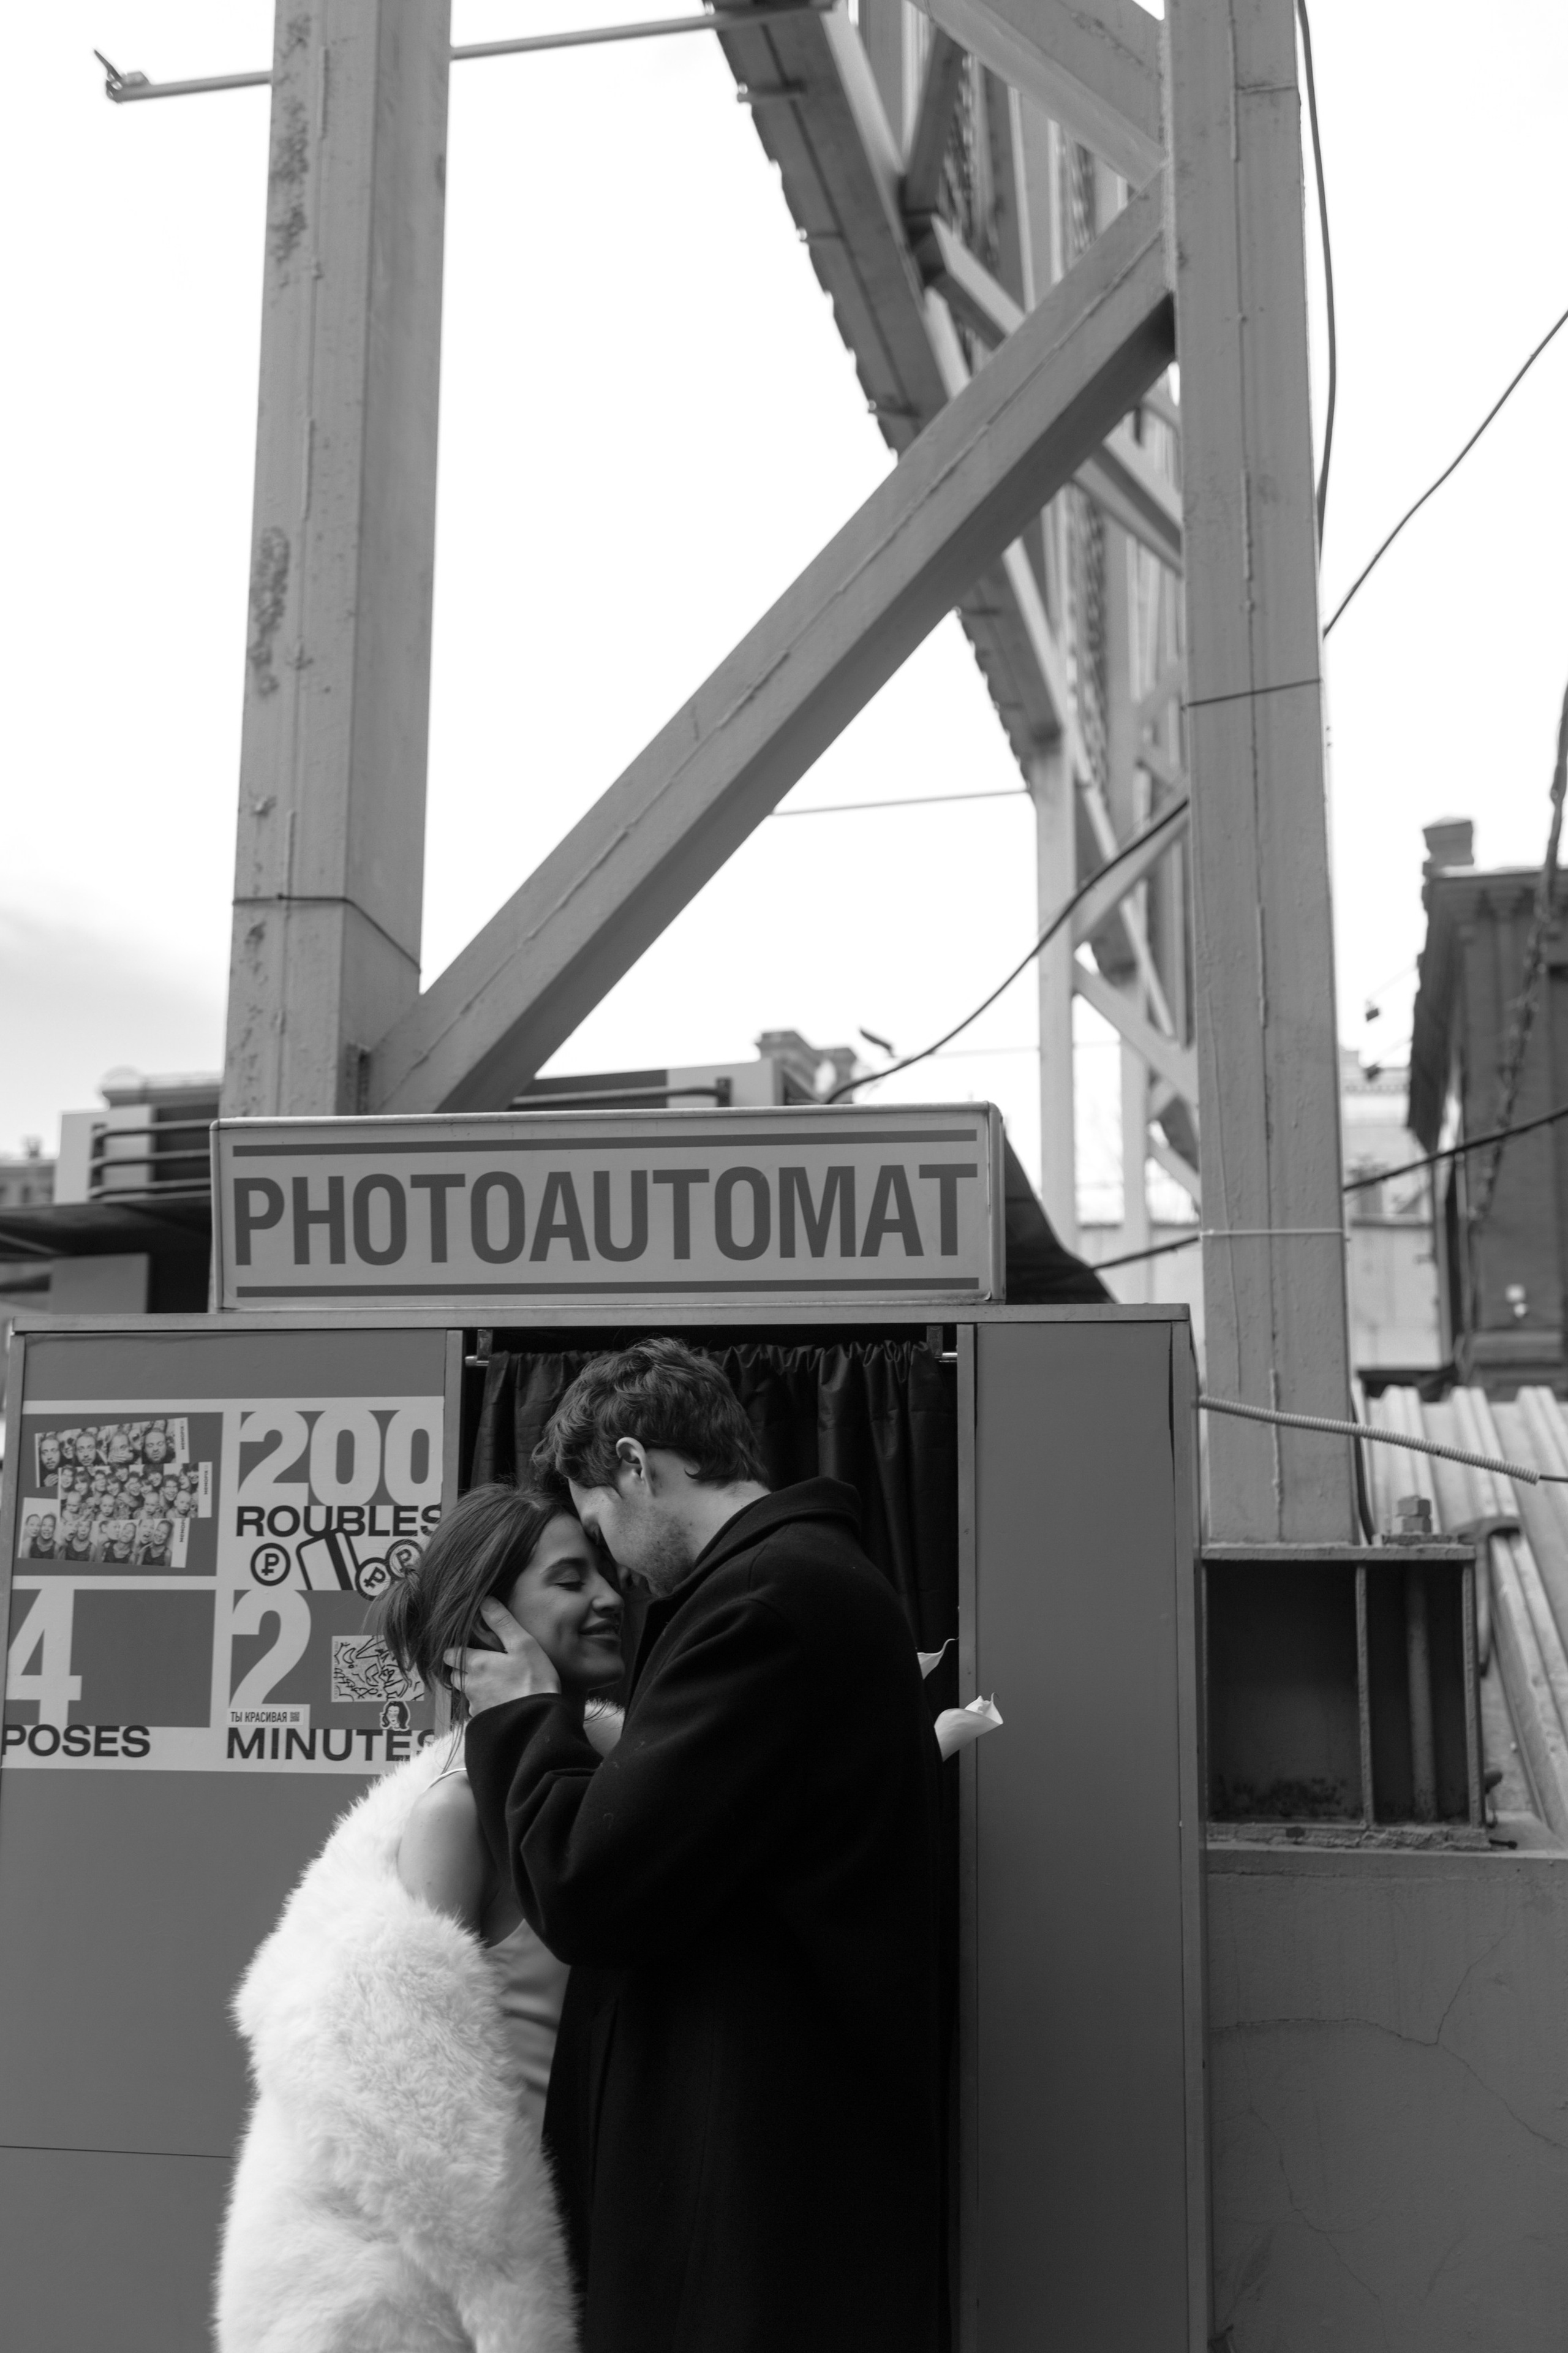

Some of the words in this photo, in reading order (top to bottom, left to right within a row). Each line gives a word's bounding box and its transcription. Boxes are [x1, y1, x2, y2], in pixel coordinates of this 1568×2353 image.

[233, 1163, 978, 1266] PHOTOAUTOMAT
[238, 1410, 442, 1506] 200
[6, 1589, 82, 1726] 4
[230, 1590, 311, 1728] 2
[2, 1724, 151, 1758] POSES
[230, 1711, 243, 1723] ТЫ
[244, 1711, 287, 1723] КРАСИВАЯ
